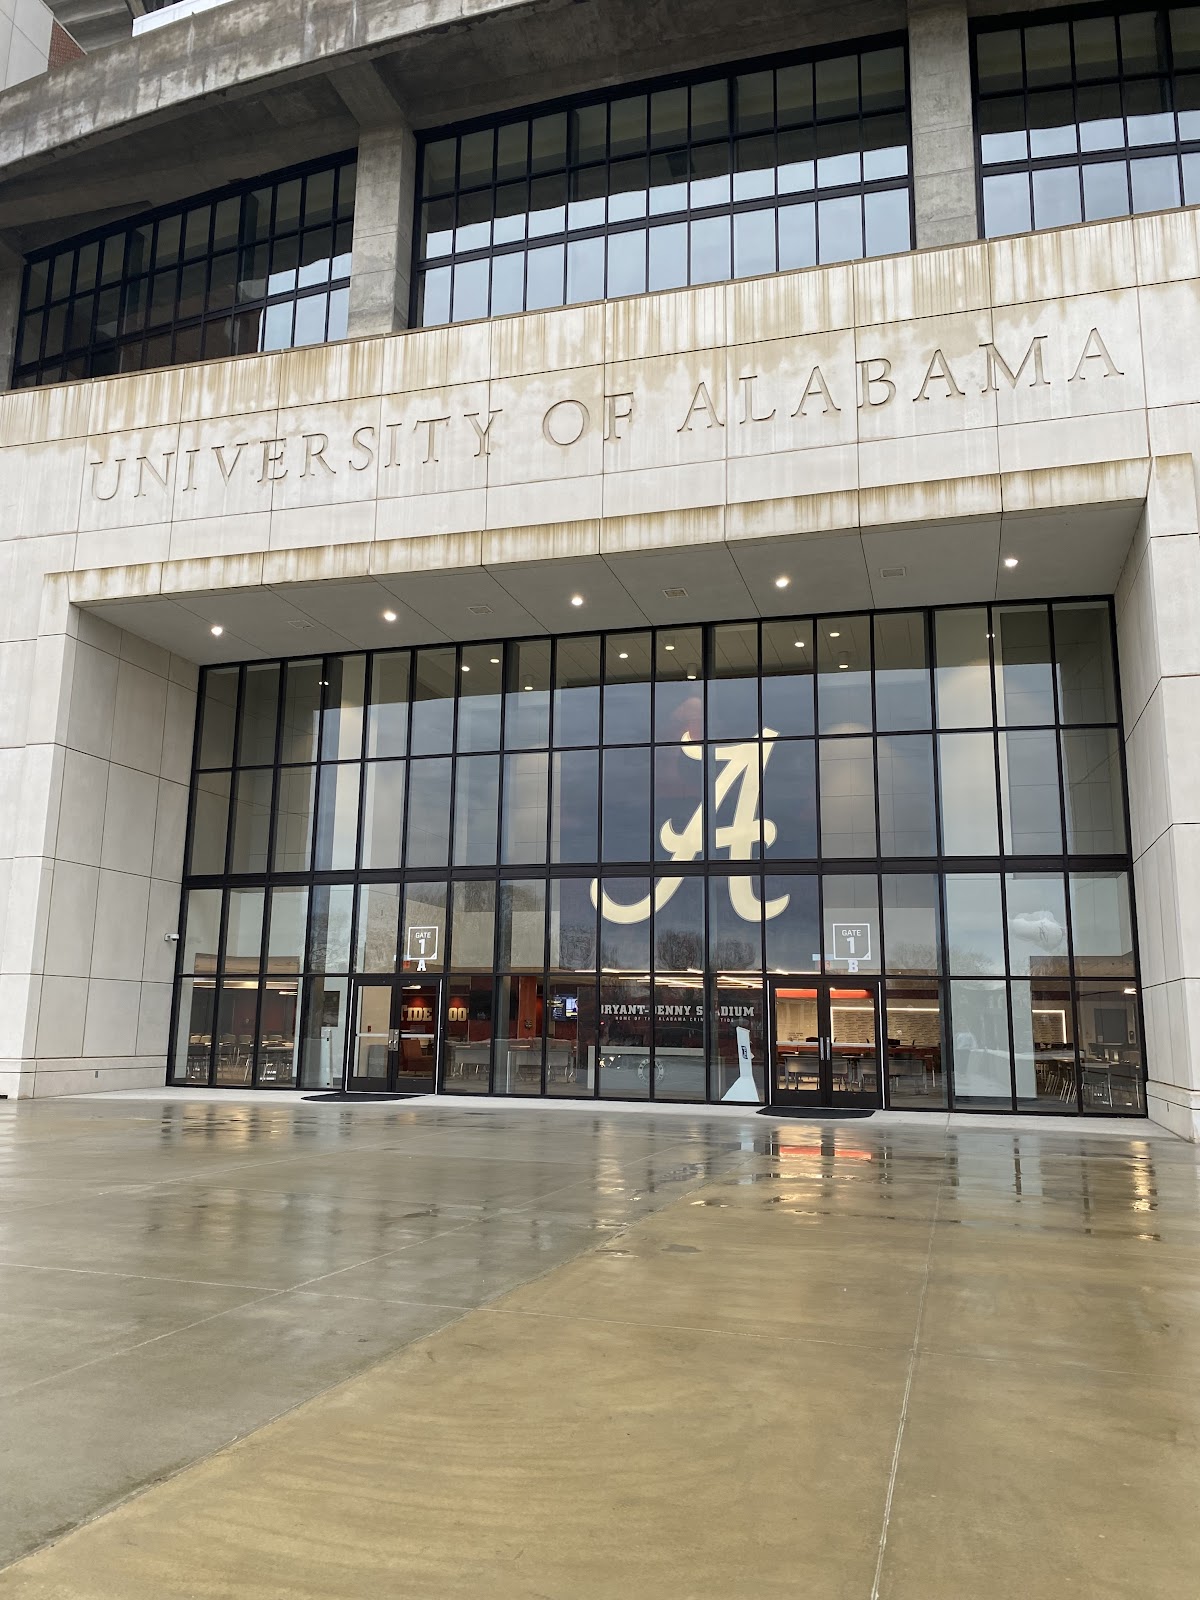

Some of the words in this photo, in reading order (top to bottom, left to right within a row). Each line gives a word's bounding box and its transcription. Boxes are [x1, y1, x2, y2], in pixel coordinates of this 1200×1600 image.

[90, 408, 503, 502] UNIVERSITY
[542, 391, 636, 448] OF
[676, 326, 1125, 434] ALABAMA
[590, 727, 791, 923] A
[415, 931, 431, 939] GATE
[841, 929, 862, 937] GATE
[419, 938, 427, 955] 1
[846, 937, 855, 954] 1
[416, 959, 427, 972] A
[848, 959, 859, 972] B
[601, 1004, 691, 1016] RYANT-ENNY
[696, 1005, 755, 1017] SDIUM
